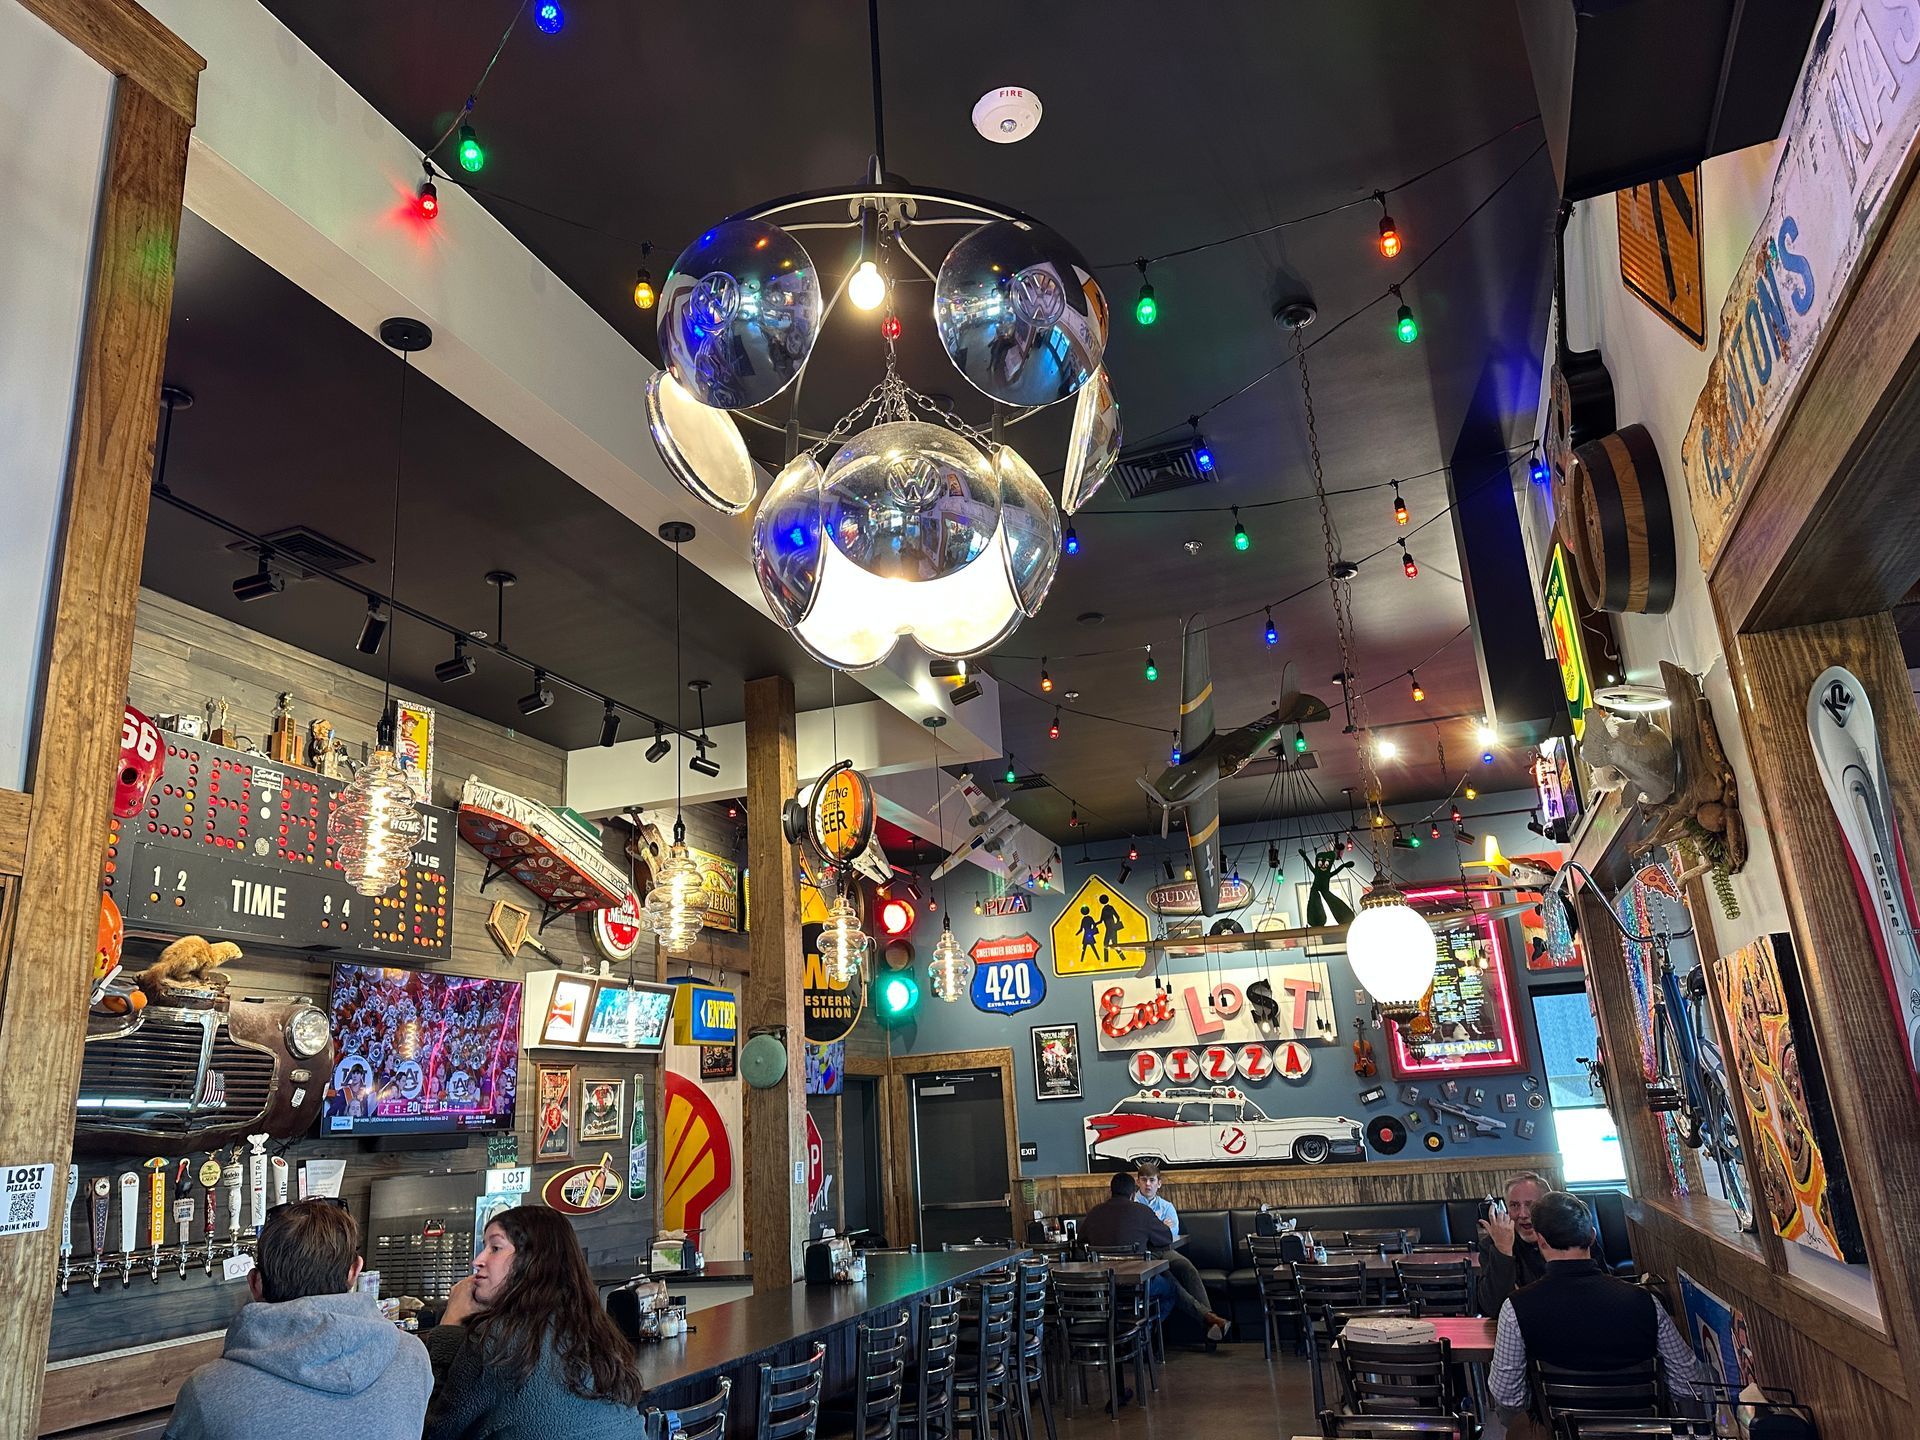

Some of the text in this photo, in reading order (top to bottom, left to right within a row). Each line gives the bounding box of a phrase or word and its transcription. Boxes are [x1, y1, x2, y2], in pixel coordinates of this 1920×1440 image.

[1823, 682, 1853, 723] K2
[823, 810, 847, 835] EER
[231, 879, 287, 919] TIME
[1155, 886, 1243, 904] BUDWER
[1872, 851, 1899, 929] escape
[986, 896, 1027, 916] PIZZA
[976, 946, 1005, 958] SWEETWATER
[1005, 944, 1025, 956] BREWING
[985, 963, 1031, 1002] 420
[805, 996, 850, 1006] ESTERN
[1101, 978, 1322, 1038] Eat LOST
[707, 999, 736, 1030] ENTER
[812, 1008, 850, 1018] UNION
[1138, 1044, 1303, 1082] PIZZA
[1021, 1147, 1036, 1156] EXIT
[7, 1167, 45, 1184] LOST
[503, 1172, 525, 1184] LOST
[6, 1182, 43, 1192] PIZZA CO.
[0, 1221, 40, 1232] DRINK MENU
[229, 1261, 251, 1275] OUT
